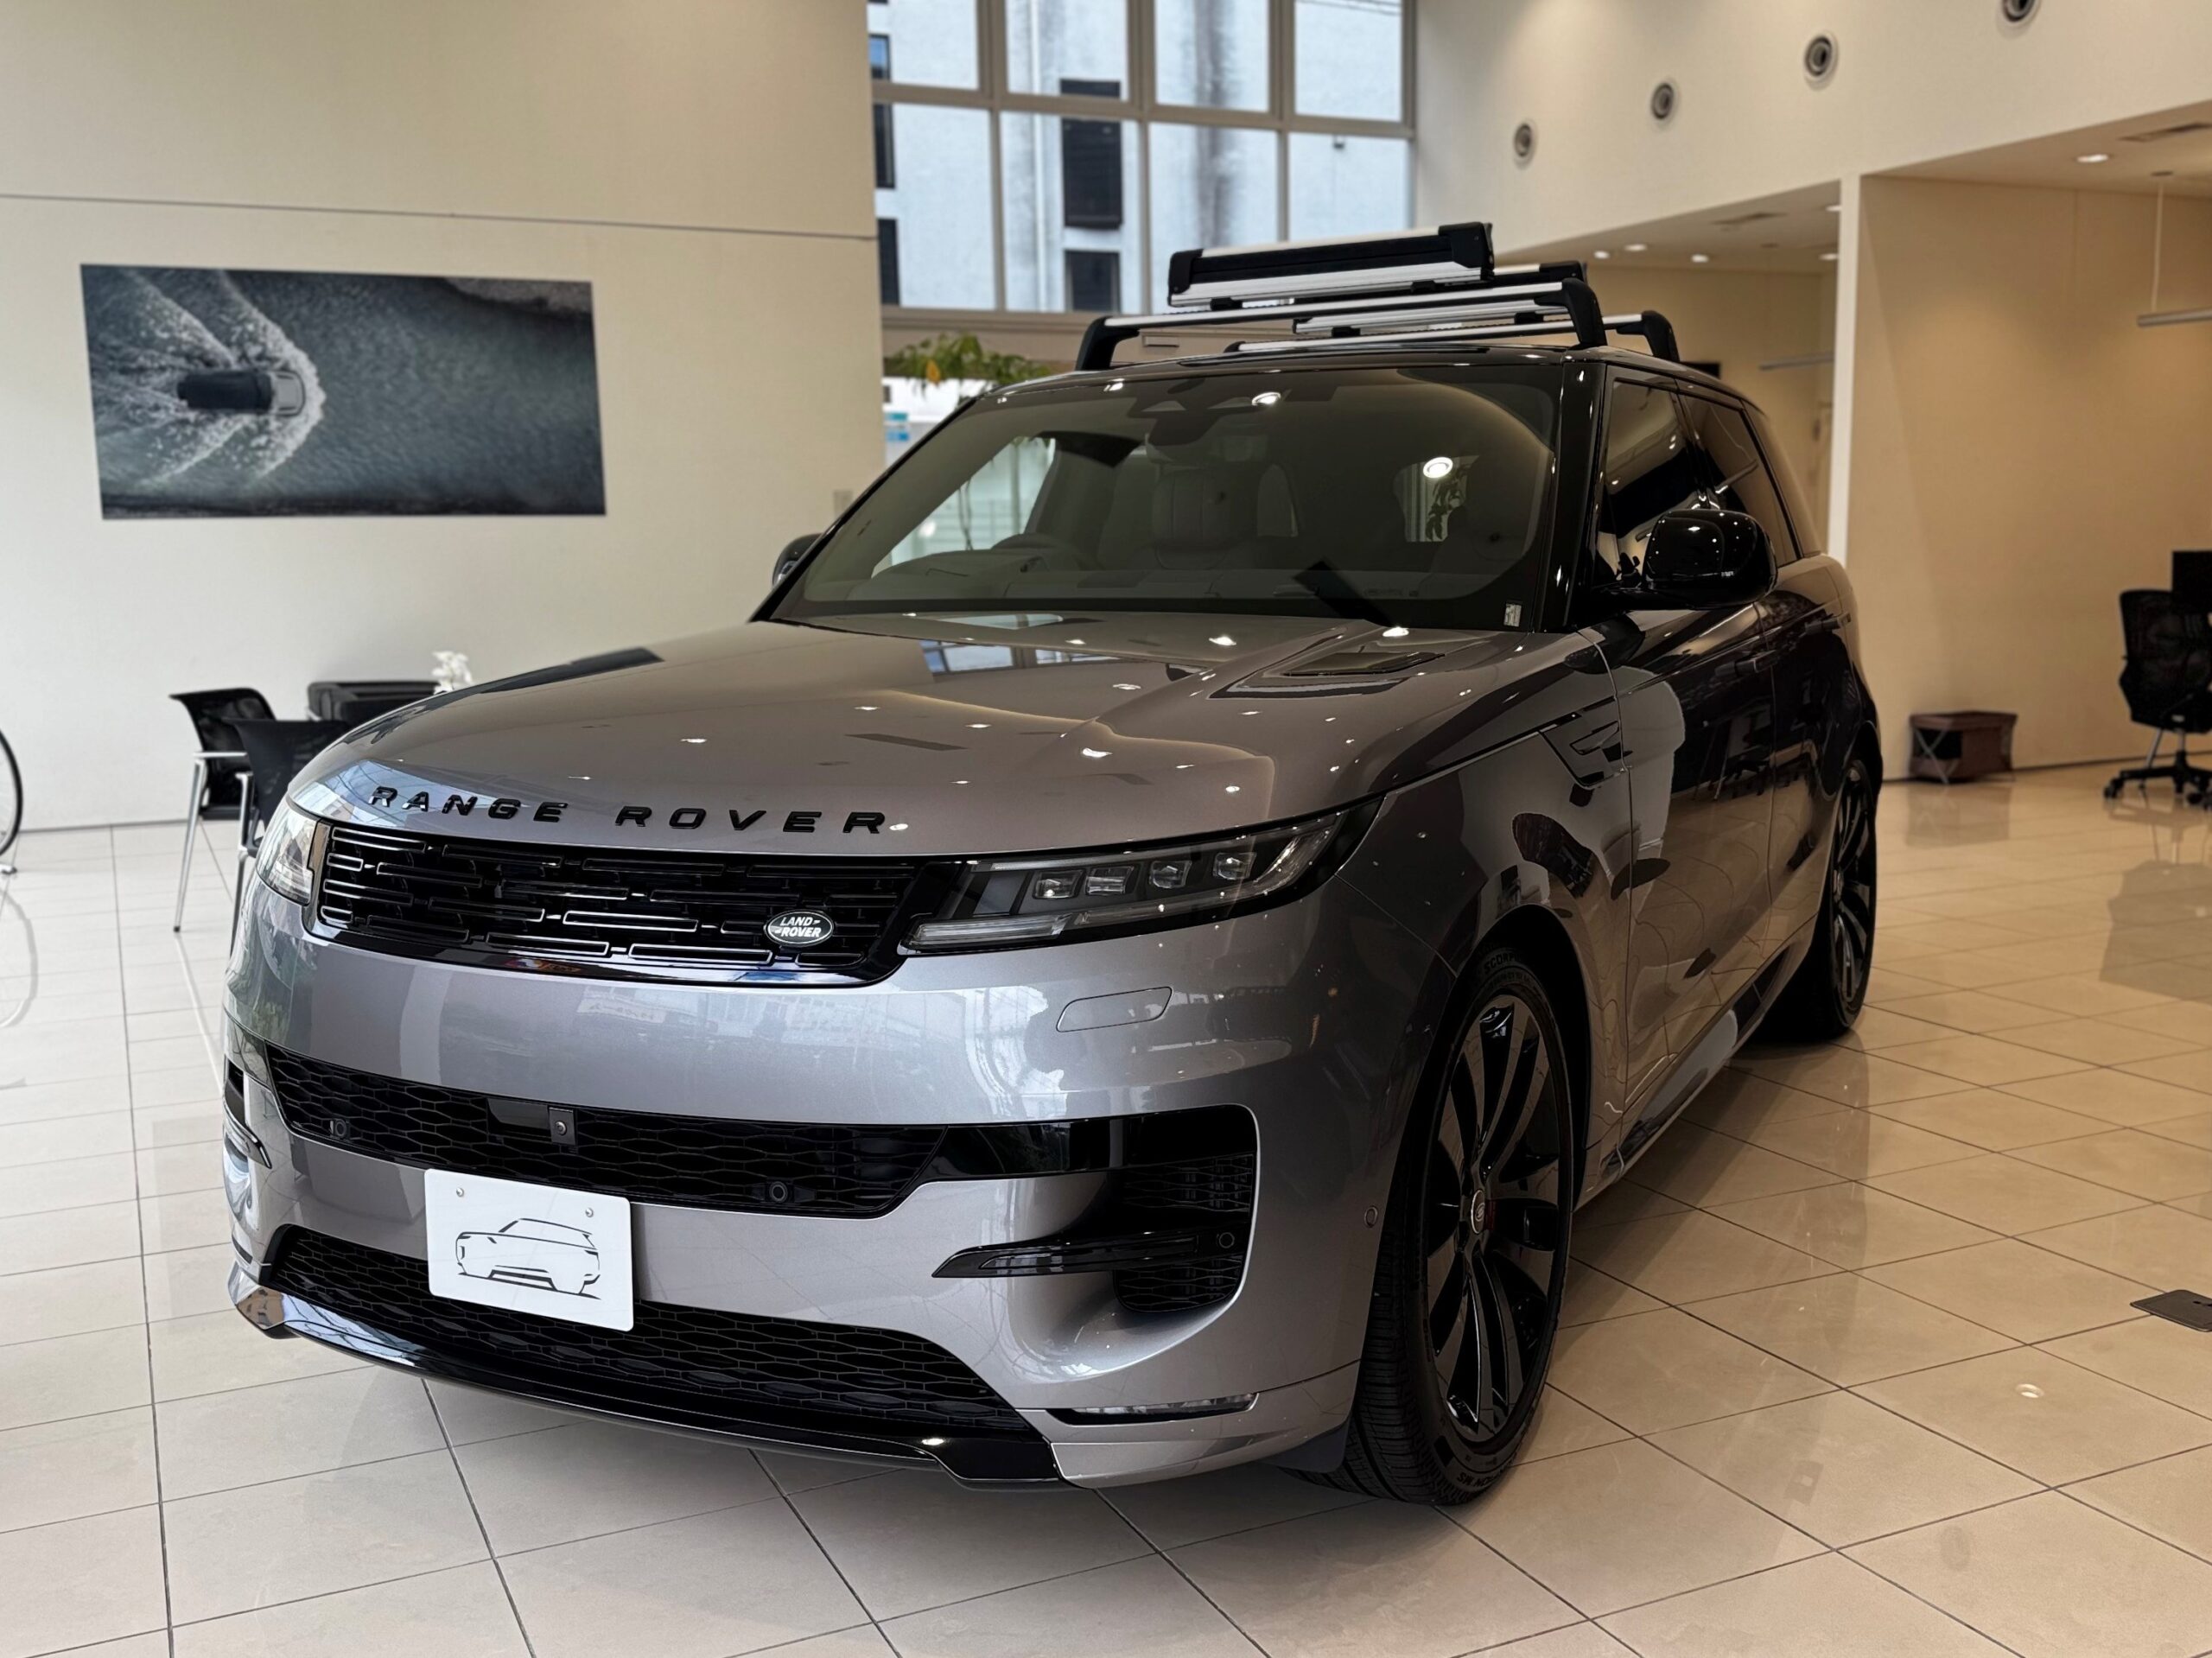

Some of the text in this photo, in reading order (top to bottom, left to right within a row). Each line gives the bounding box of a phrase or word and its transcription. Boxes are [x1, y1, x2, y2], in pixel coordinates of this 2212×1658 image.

[368, 785, 886, 834] RANGE ROVER
[779, 917, 813, 926] LAND
[780, 926, 822, 937] ROVER
